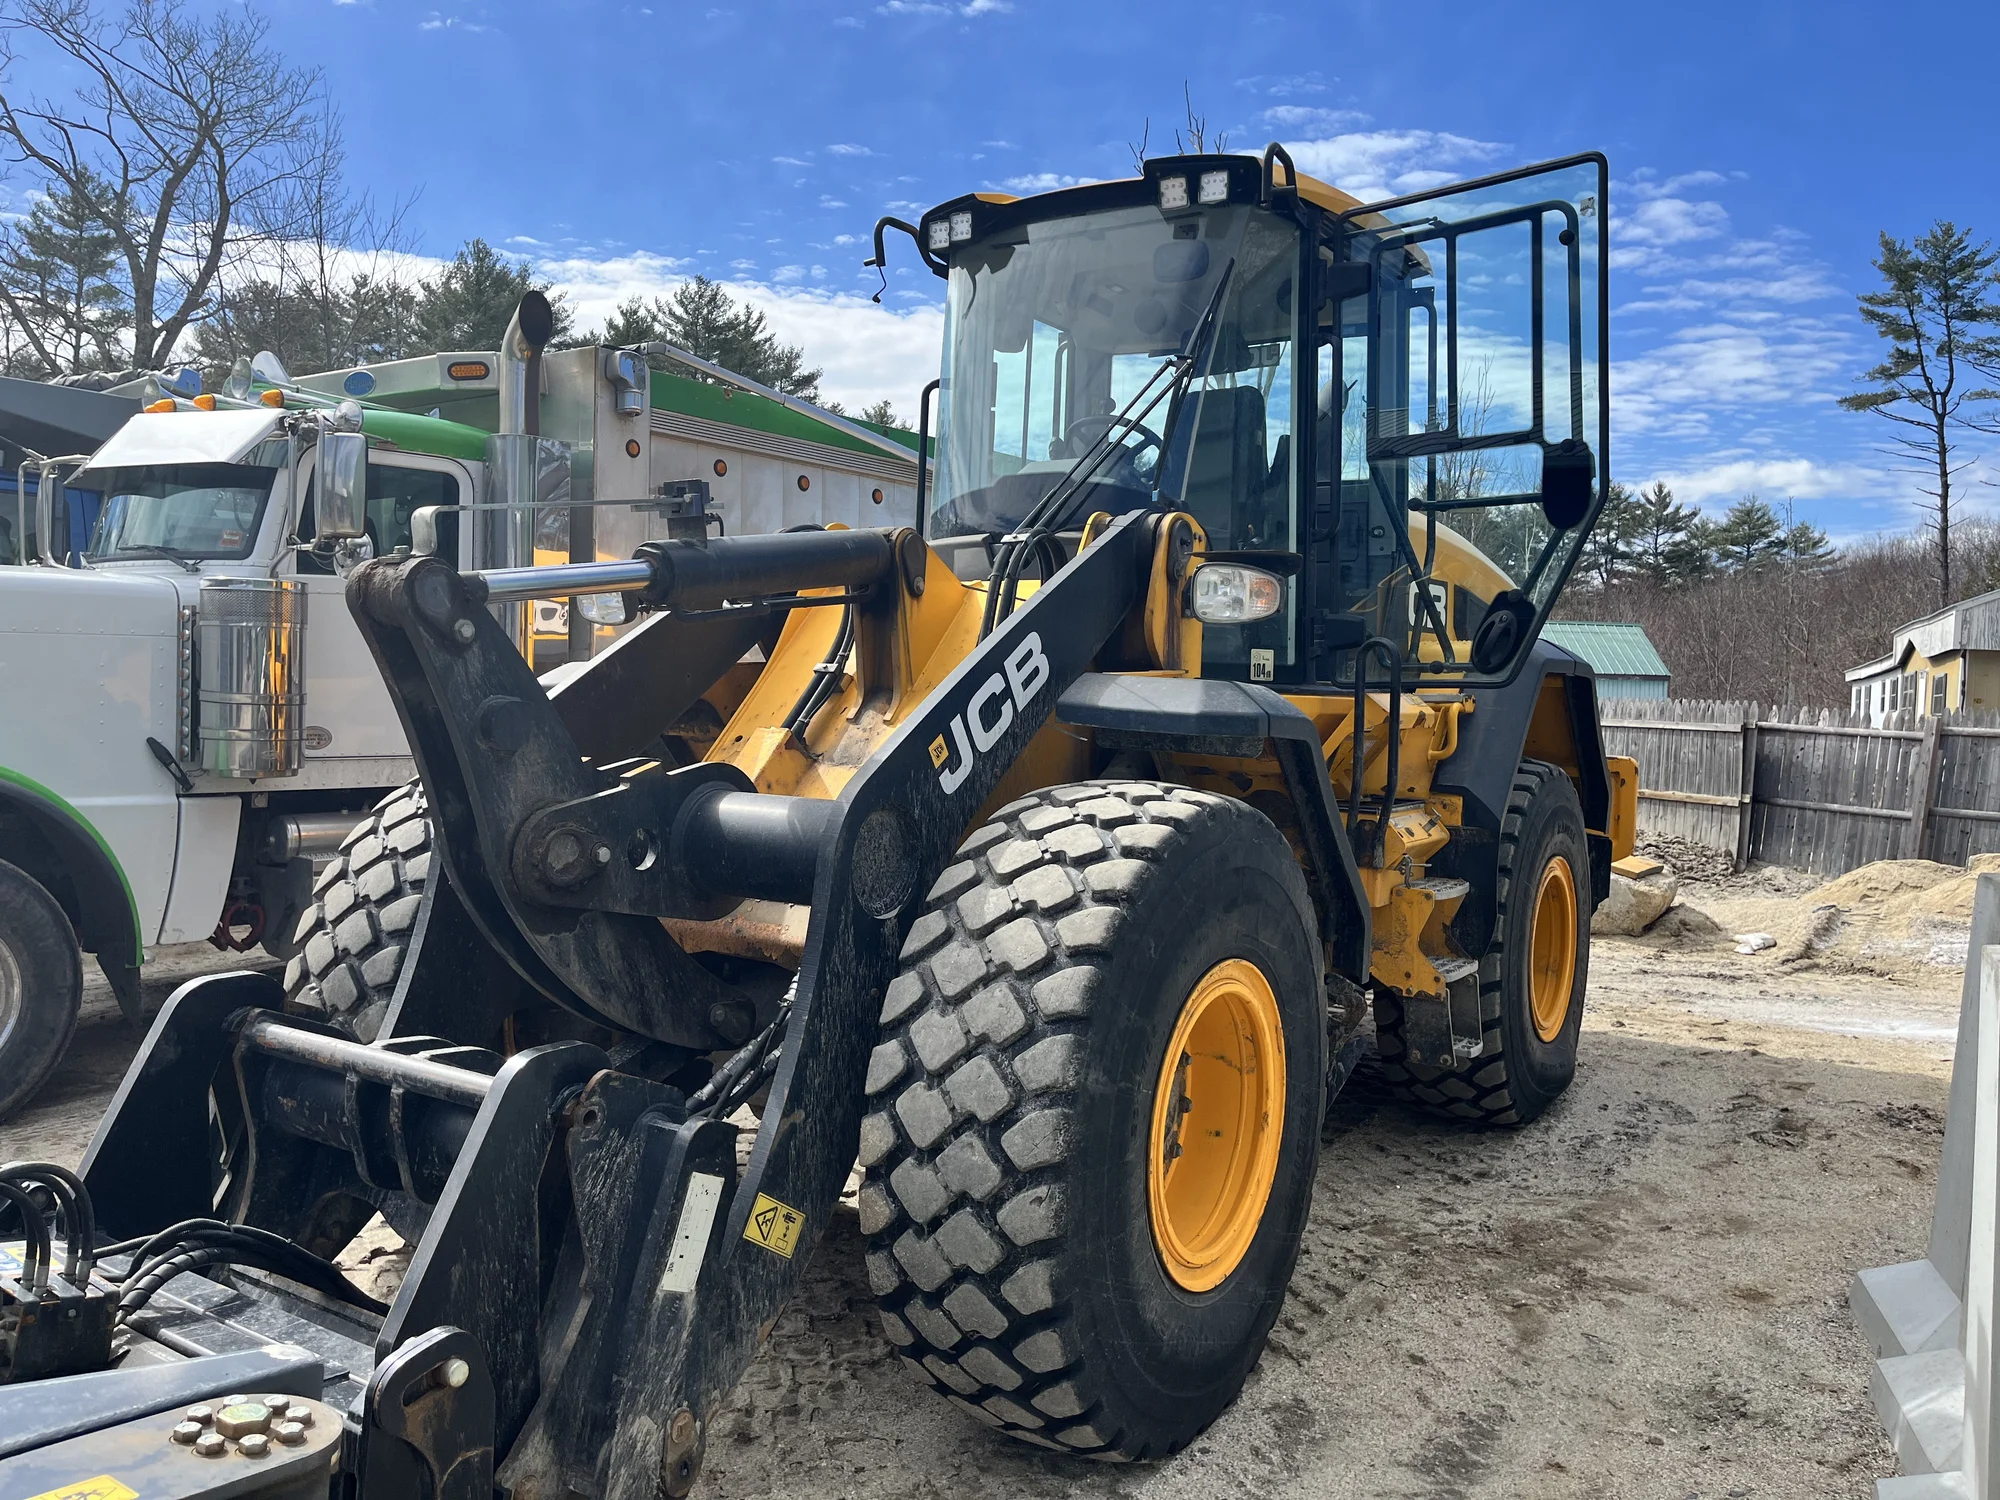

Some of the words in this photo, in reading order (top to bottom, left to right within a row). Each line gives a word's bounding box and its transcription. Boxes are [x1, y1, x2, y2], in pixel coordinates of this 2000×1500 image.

[1252, 662, 1266, 678] 104
[939, 631, 1050, 795] JCB
[933, 743, 945, 760] JCB
